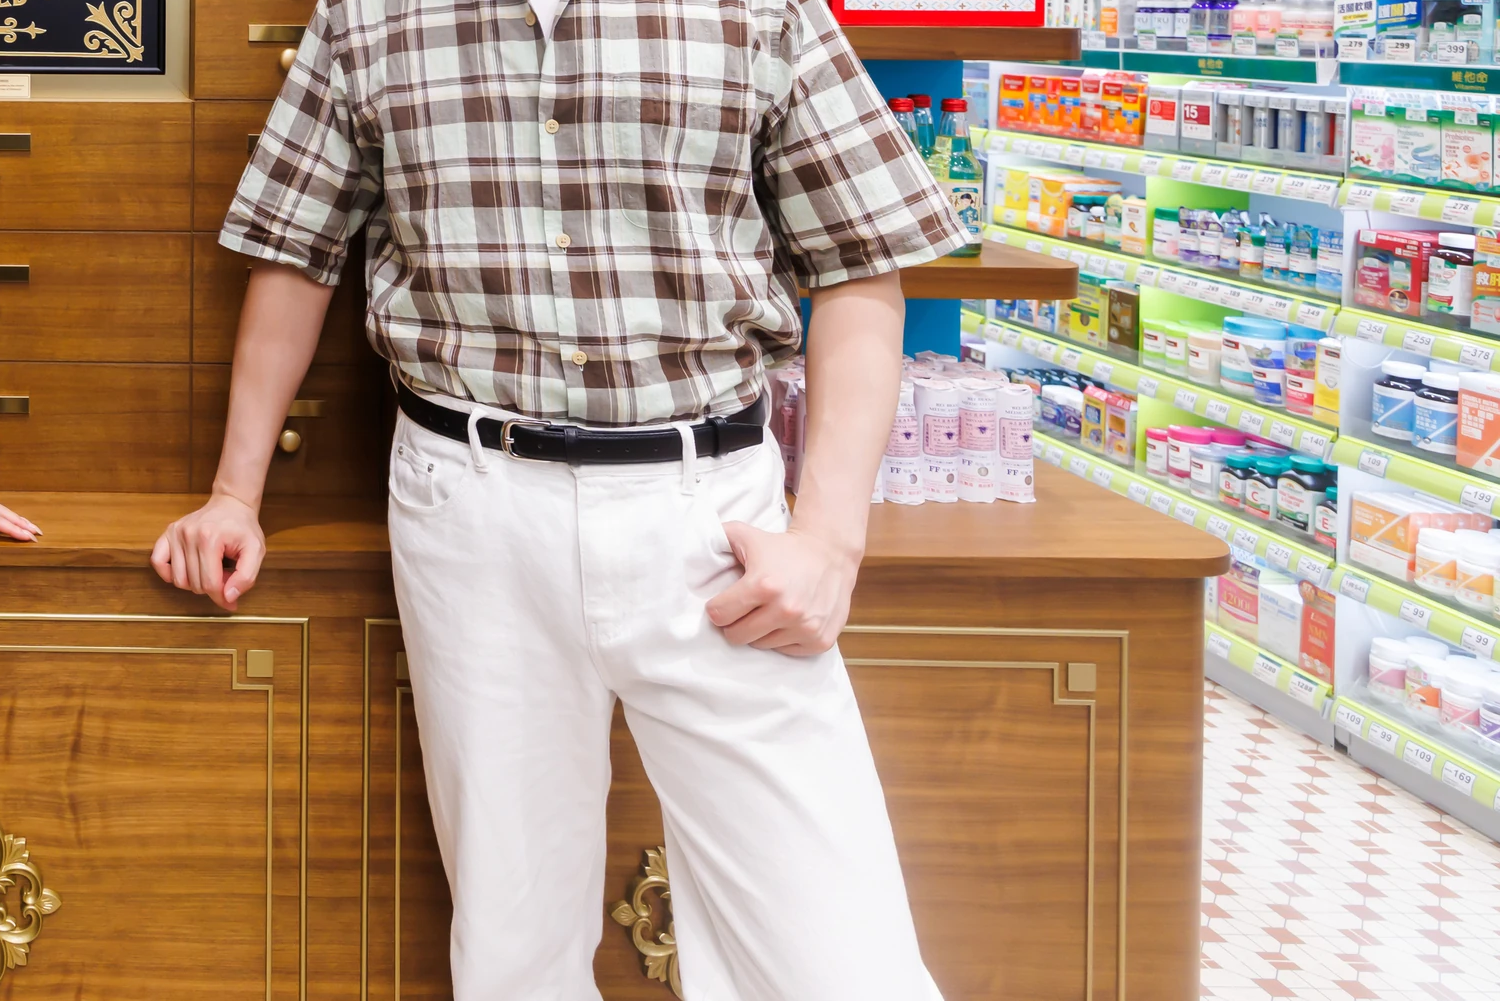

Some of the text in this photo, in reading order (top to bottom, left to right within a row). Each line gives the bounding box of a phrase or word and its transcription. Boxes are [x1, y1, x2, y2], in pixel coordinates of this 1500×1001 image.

[1446, 45, 1465, 53] 399
[1452, 71, 1488, 83] 維他命
[1454, 83, 1486, 91] Vitamins
[1184, 104, 1198, 119] 15
[1445, 133, 1475, 142] Probiotics
[1366, 323, 1384, 334] 358
[1413, 334, 1431, 346] 259
[1470, 346, 1490, 360] 378
[1214, 403, 1227, 414] 199
[1277, 425, 1293, 437] 369
[1309, 438, 1324, 447] 140
[962, 458, 973, 466] FF
[1367, 457, 1381, 466] 109
[890, 466, 901, 474] FF
[929, 465, 940, 473] FF
[1224, 479, 1231, 489] B
[1251, 491, 1259, 501] C
[1473, 492, 1492, 503] 199
[1321, 517, 1329, 529] E
[1274, 548, 1289, 559] 275
[1306, 562, 1321, 574] 295
[1413, 608, 1425, 619] 99
[1476, 635, 1489, 646] 99
[1346, 712, 1361, 725] 109
[1380, 731, 1392, 742] 99
[1415, 750, 1432, 763] 109
[1454, 769, 1472, 784] 169
